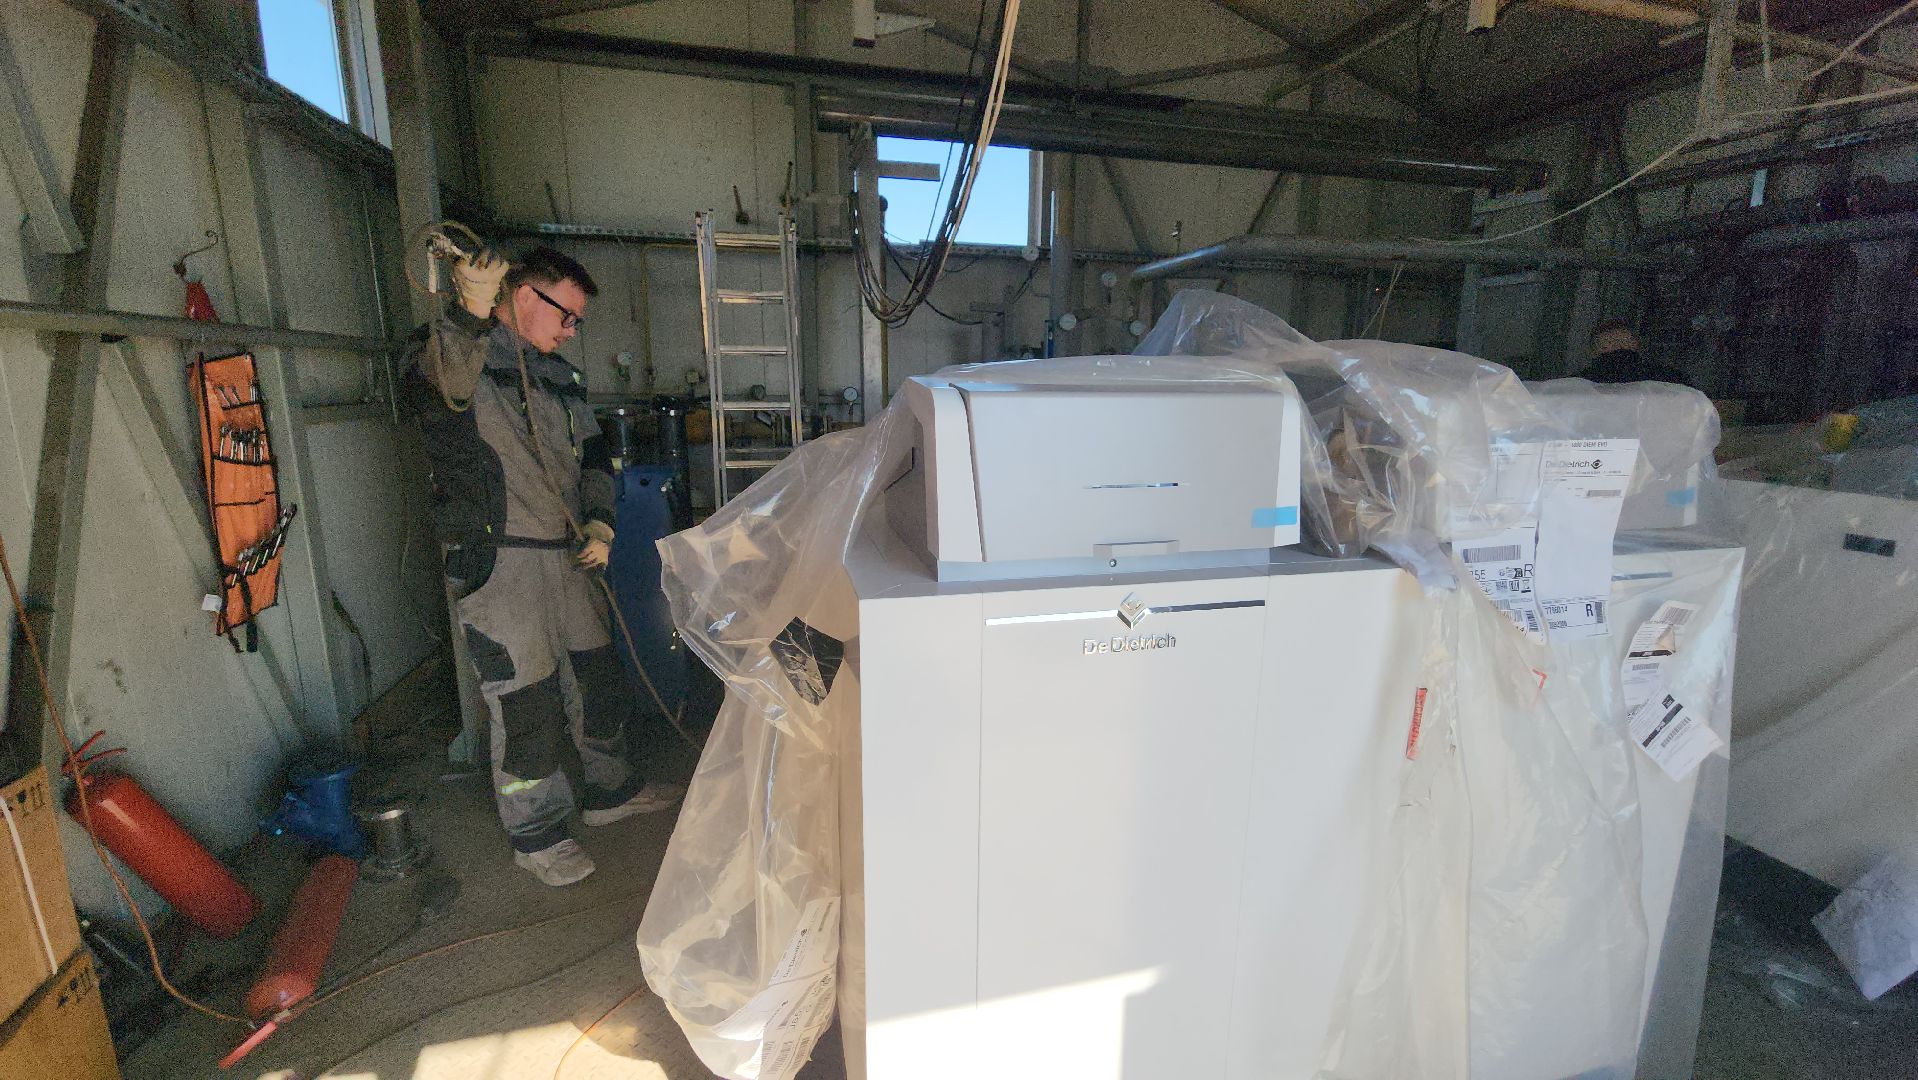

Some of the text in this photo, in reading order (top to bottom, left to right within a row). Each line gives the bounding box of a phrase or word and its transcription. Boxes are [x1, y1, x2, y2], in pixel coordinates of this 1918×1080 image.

[1524, 563, 1534, 577] R
[1585, 603, 1594, 617] R
[1083, 633, 1176, 656] De Dietrich
